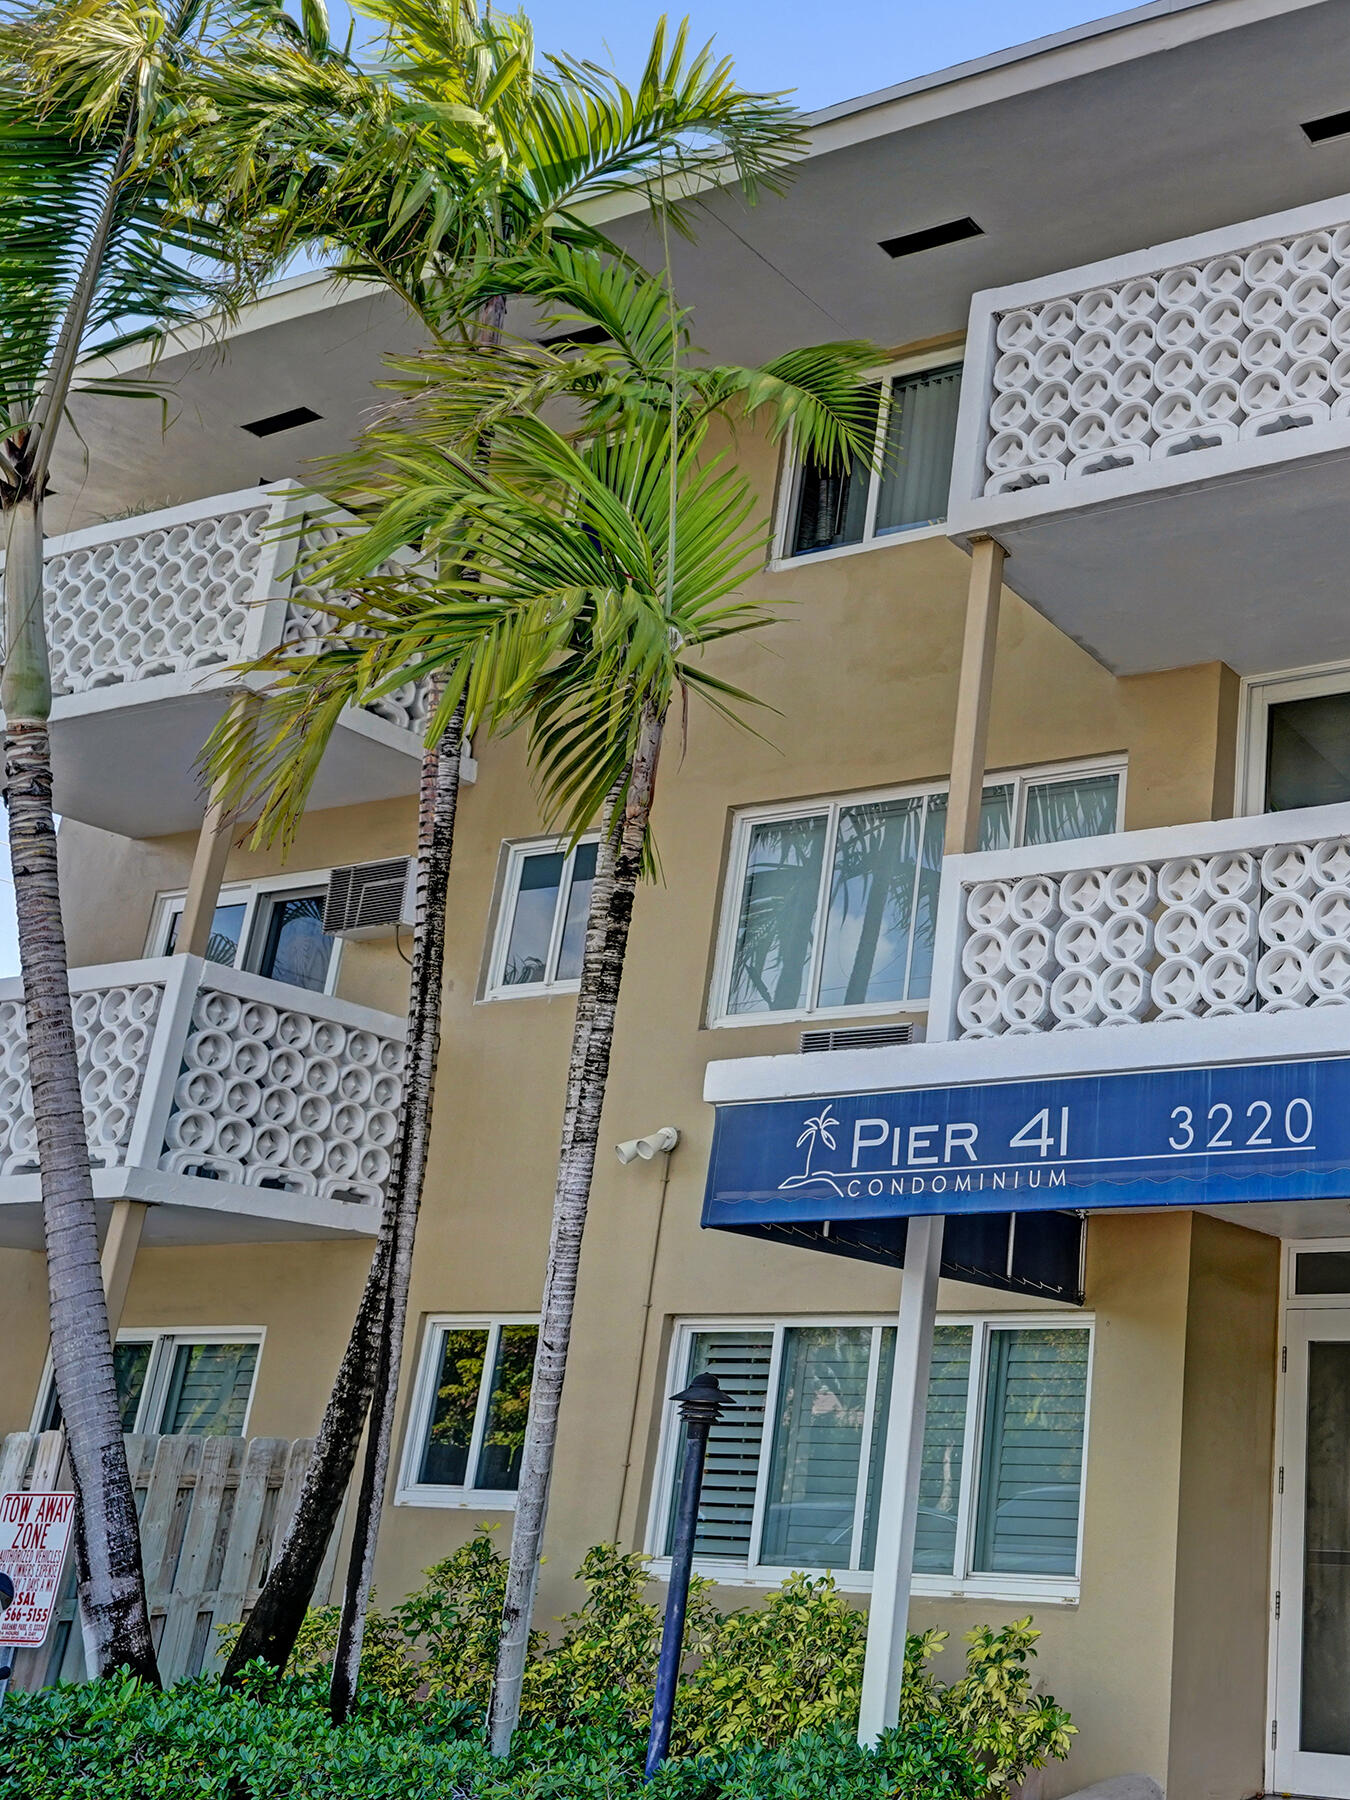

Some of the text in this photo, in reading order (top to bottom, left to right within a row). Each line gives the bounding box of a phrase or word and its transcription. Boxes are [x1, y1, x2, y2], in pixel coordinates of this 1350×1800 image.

[851, 1097, 1313, 1168] PIER 41 3220
[847, 1169, 1067, 1197] CONDOMINIUM
[3, 1497, 73, 1523] TOW AWAY
[11, 1523, 51, 1549] ZONE
[33, 1549, 61, 1563] VEHICLES
[13, 1563, 35, 1577] OWNERS
[34, 1563, 58, 1578] EXPENSE
[26, 1577, 40, 1592] DAYS
[4, 1607, 49, 1622] 566-5155
